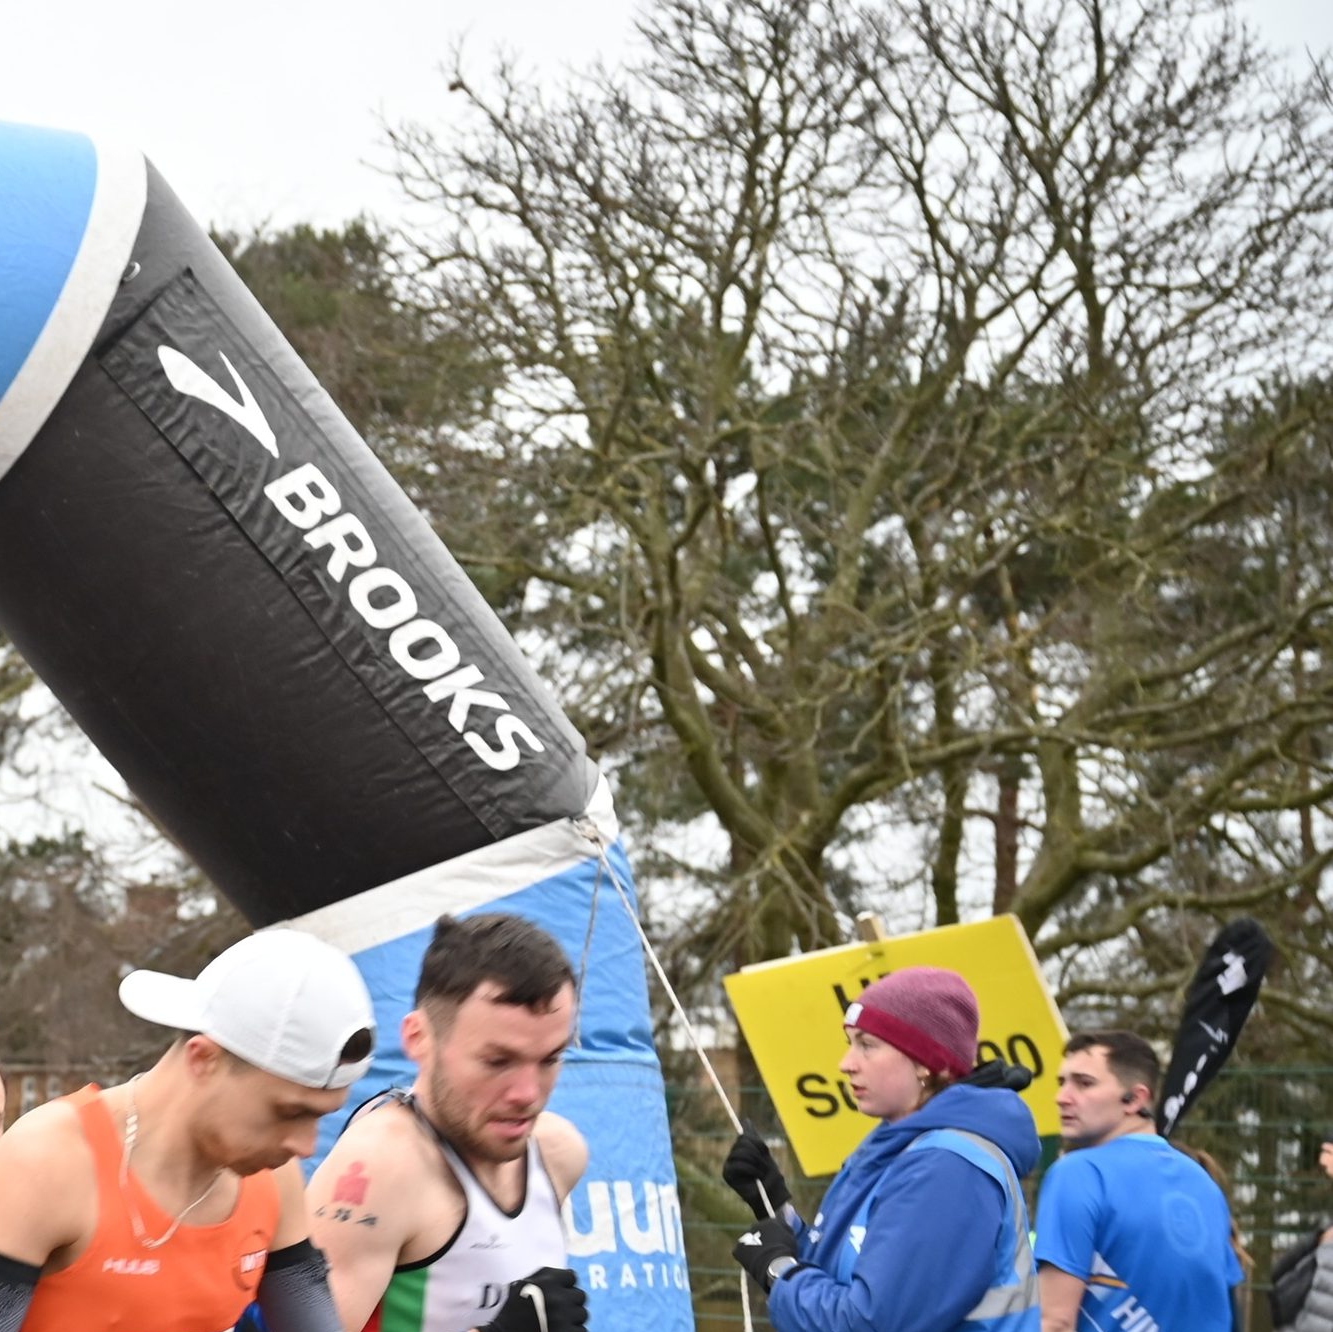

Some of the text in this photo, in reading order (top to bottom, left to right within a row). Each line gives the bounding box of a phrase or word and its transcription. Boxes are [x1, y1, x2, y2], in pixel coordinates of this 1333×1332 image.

[264, 462, 545, 771] BROOKS
[588, 1263, 691, 1292] RATIO
[477, 1282, 502, 1309] D
